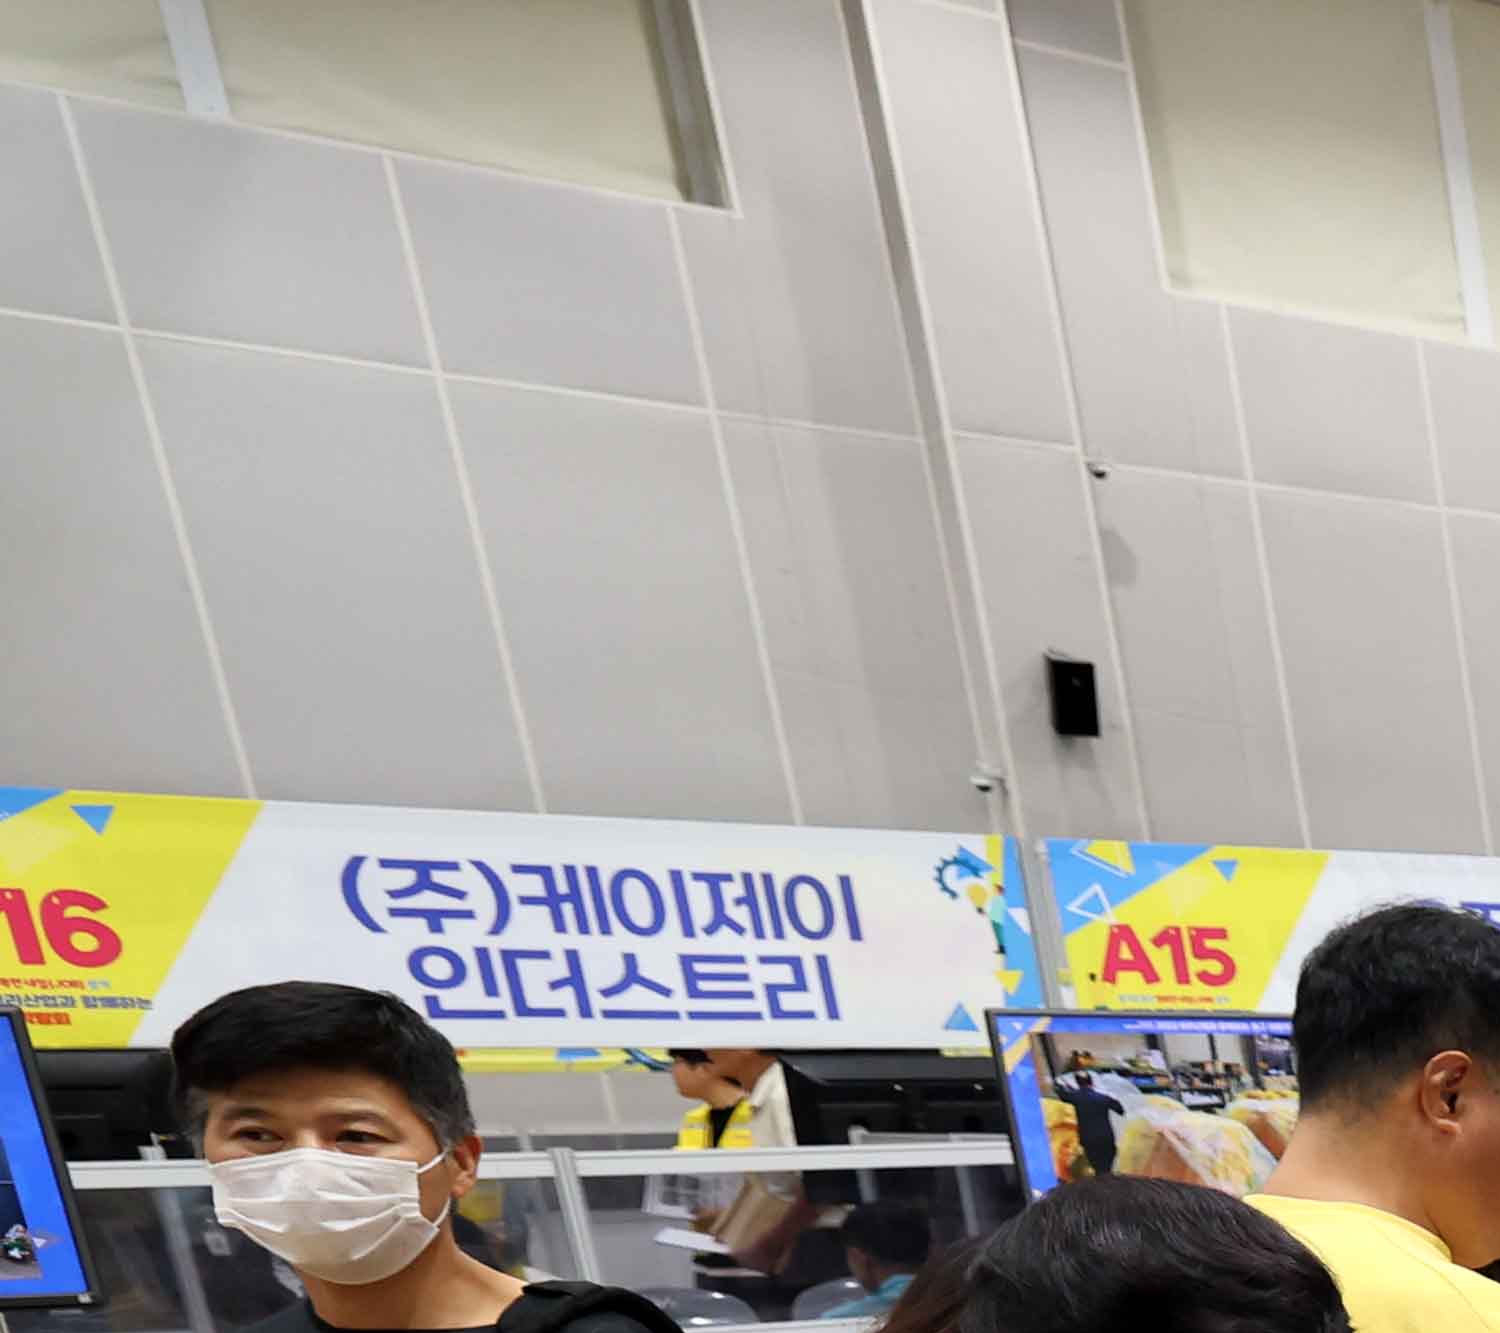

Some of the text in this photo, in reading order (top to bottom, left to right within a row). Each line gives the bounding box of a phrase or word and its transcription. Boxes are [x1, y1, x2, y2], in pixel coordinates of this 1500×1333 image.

[340, 855, 864, 942] (주)케이제이
[407, 946, 843, 1021] 인더스트리
[1101, 923, 1237, 987] A15
